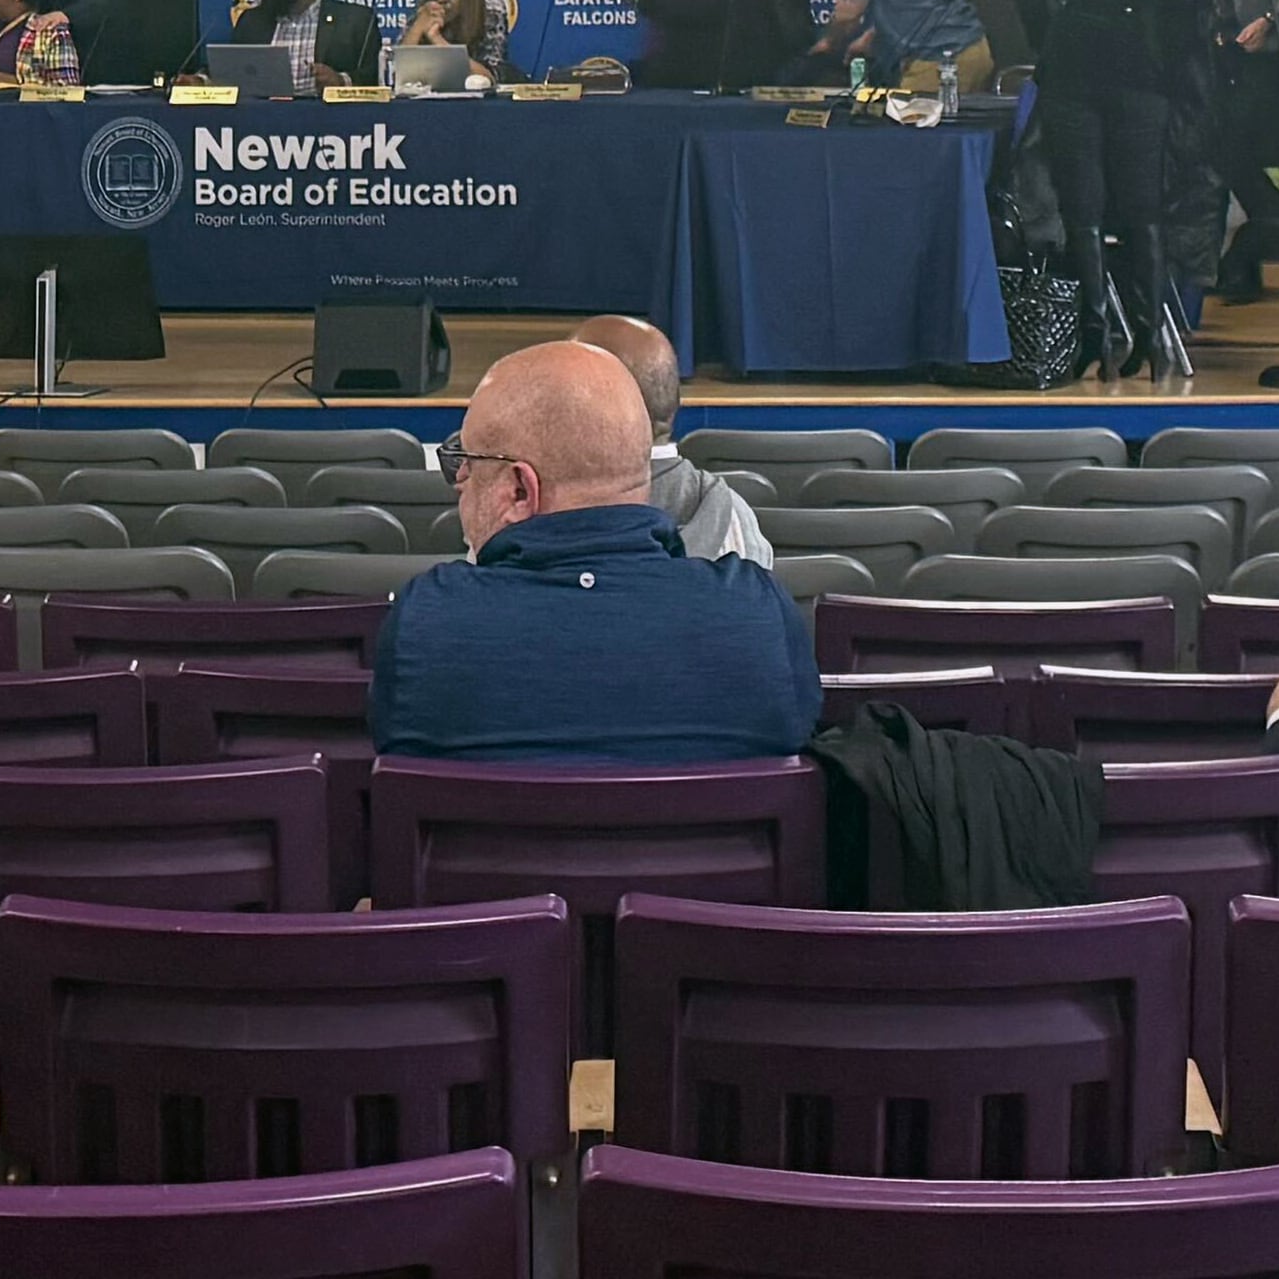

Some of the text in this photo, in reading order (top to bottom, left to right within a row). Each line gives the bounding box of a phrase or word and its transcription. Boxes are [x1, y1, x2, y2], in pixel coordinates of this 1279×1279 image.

[563, 10, 637, 25] FALCONS
[194, 123, 407, 171] Newark
[195, 177, 293, 206] Board
[304, 177, 339, 206] of
[349, 176, 517, 206] Education
[195, 212, 236, 228] Roger
[280, 212, 386, 227] Superintendent
